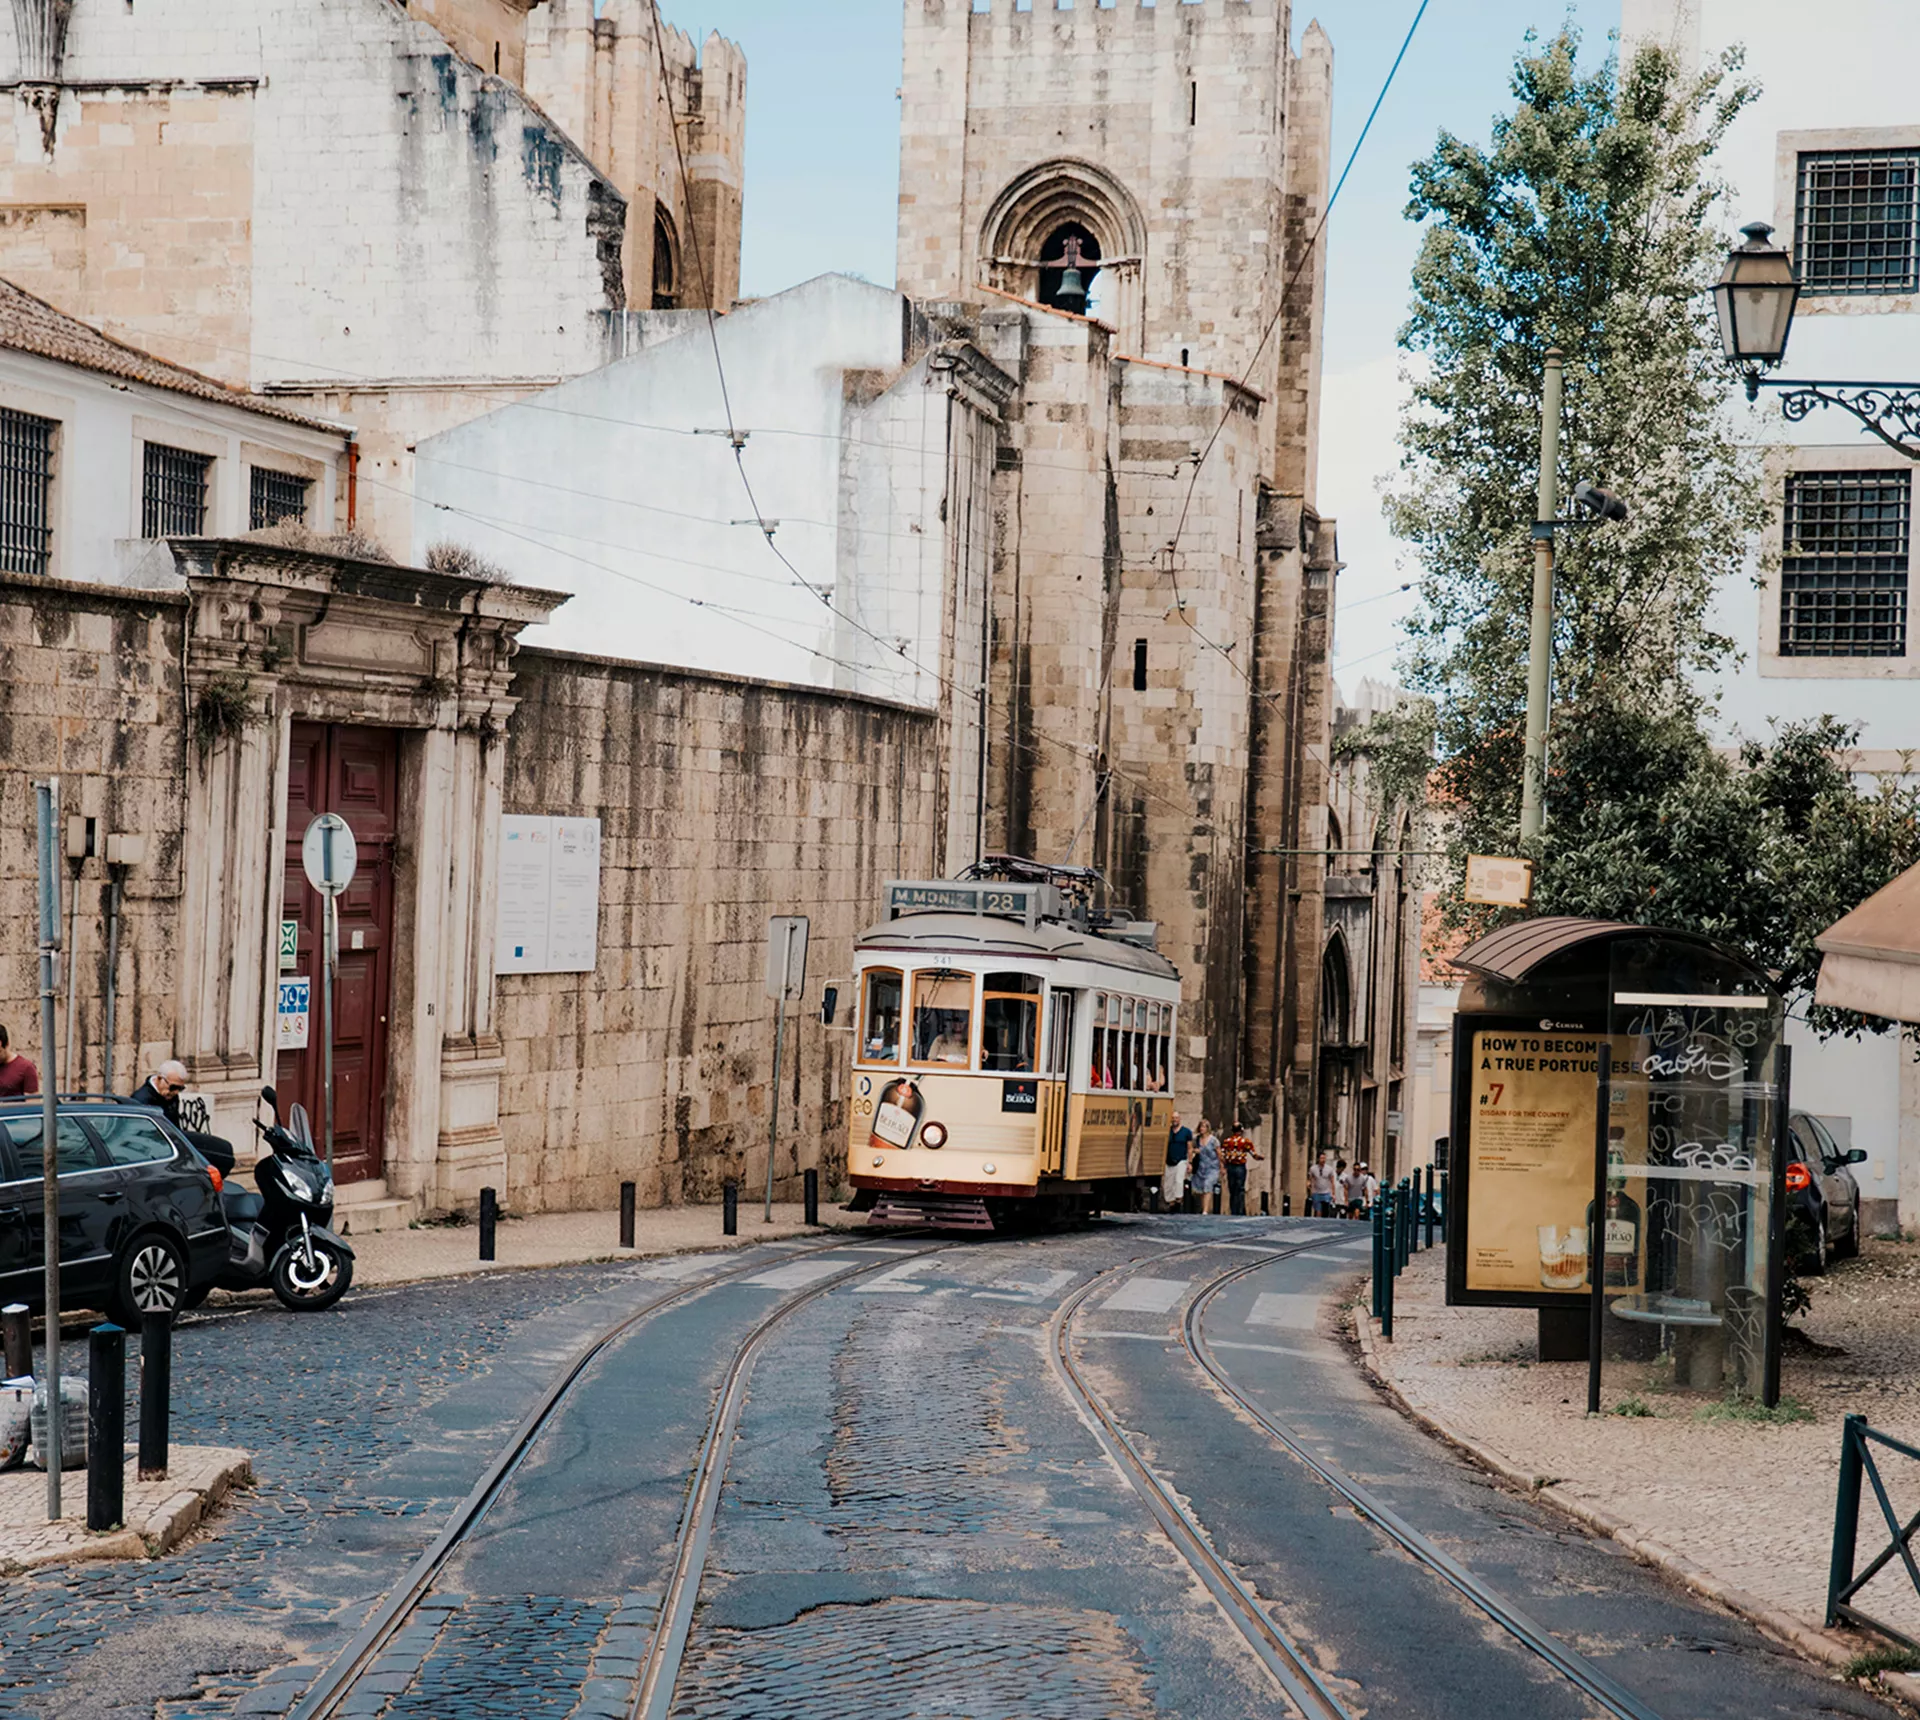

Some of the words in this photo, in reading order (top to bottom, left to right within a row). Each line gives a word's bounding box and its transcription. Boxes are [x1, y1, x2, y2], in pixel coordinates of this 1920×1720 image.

[987, 893, 1014, 911] 28
[934, 956, 952, 965] 541
[1482, 1038, 1517, 1051] HOW
[1521, 1039, 1540, 1052] TO
[1544, 1040, 1597, 1054] BECOM
[1481, 1058, 1491, 1070] A
[1495, 1058, 1535, 1071] TRUE
[1539, 1059, 1640, 1074] PORTUGESE
[1480, 1109, 1507, 1118] DISDAIN
[1509, 1110, 1522, 1118] FOR
[1523, 1110, 1536, 1118] THE
[1537, 1111, 1570, 1119] COUNTRY
